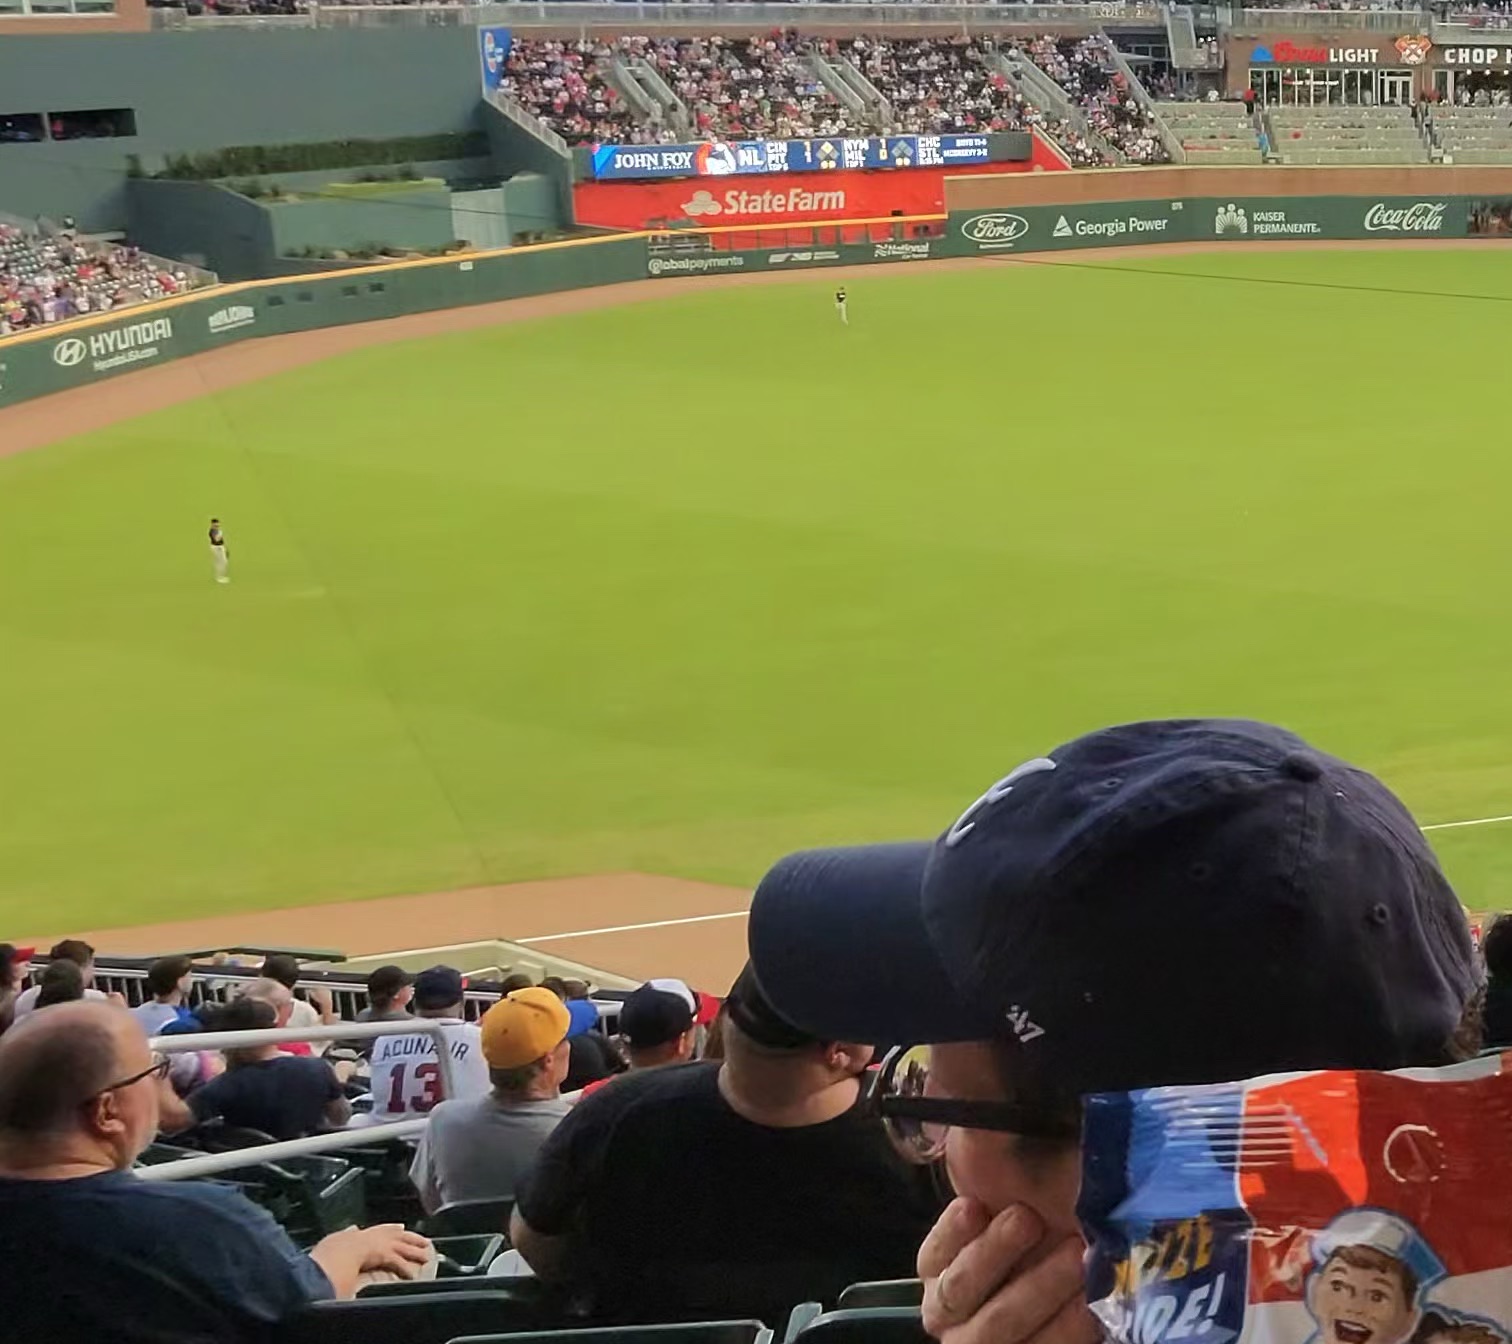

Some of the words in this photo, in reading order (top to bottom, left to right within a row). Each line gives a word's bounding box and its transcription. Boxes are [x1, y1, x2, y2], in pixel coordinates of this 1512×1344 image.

[1329, 48, 1379, 64] LIGHT
[1444, 48, 1499, 66] CHOP
[767, 141, 788, 153] CIN
[843, 138, 869, 151] NYM
[919, 147, 939, 158] STL
[615, 153, 658, 169] JOHN
[661, 152, 694, 167] FOY
[738, 150, 764, 167] NL
[723, 190, 785, 216] State
[788, 188, 845, 212] Farm
[1253, 211, 1286, 223] KAISER
[973, 216, 1017, 237] Ford
[1076, 220, 1127, 236] Georgia
[1129, 216, 1168, 233] Power
[1253, 222, 1319, 234] PERMANENTE
[887, 241, 930, 255] National
[90, 318, 172, 357] HYUNDAI
[386, 1062, 443, 1113] 13
